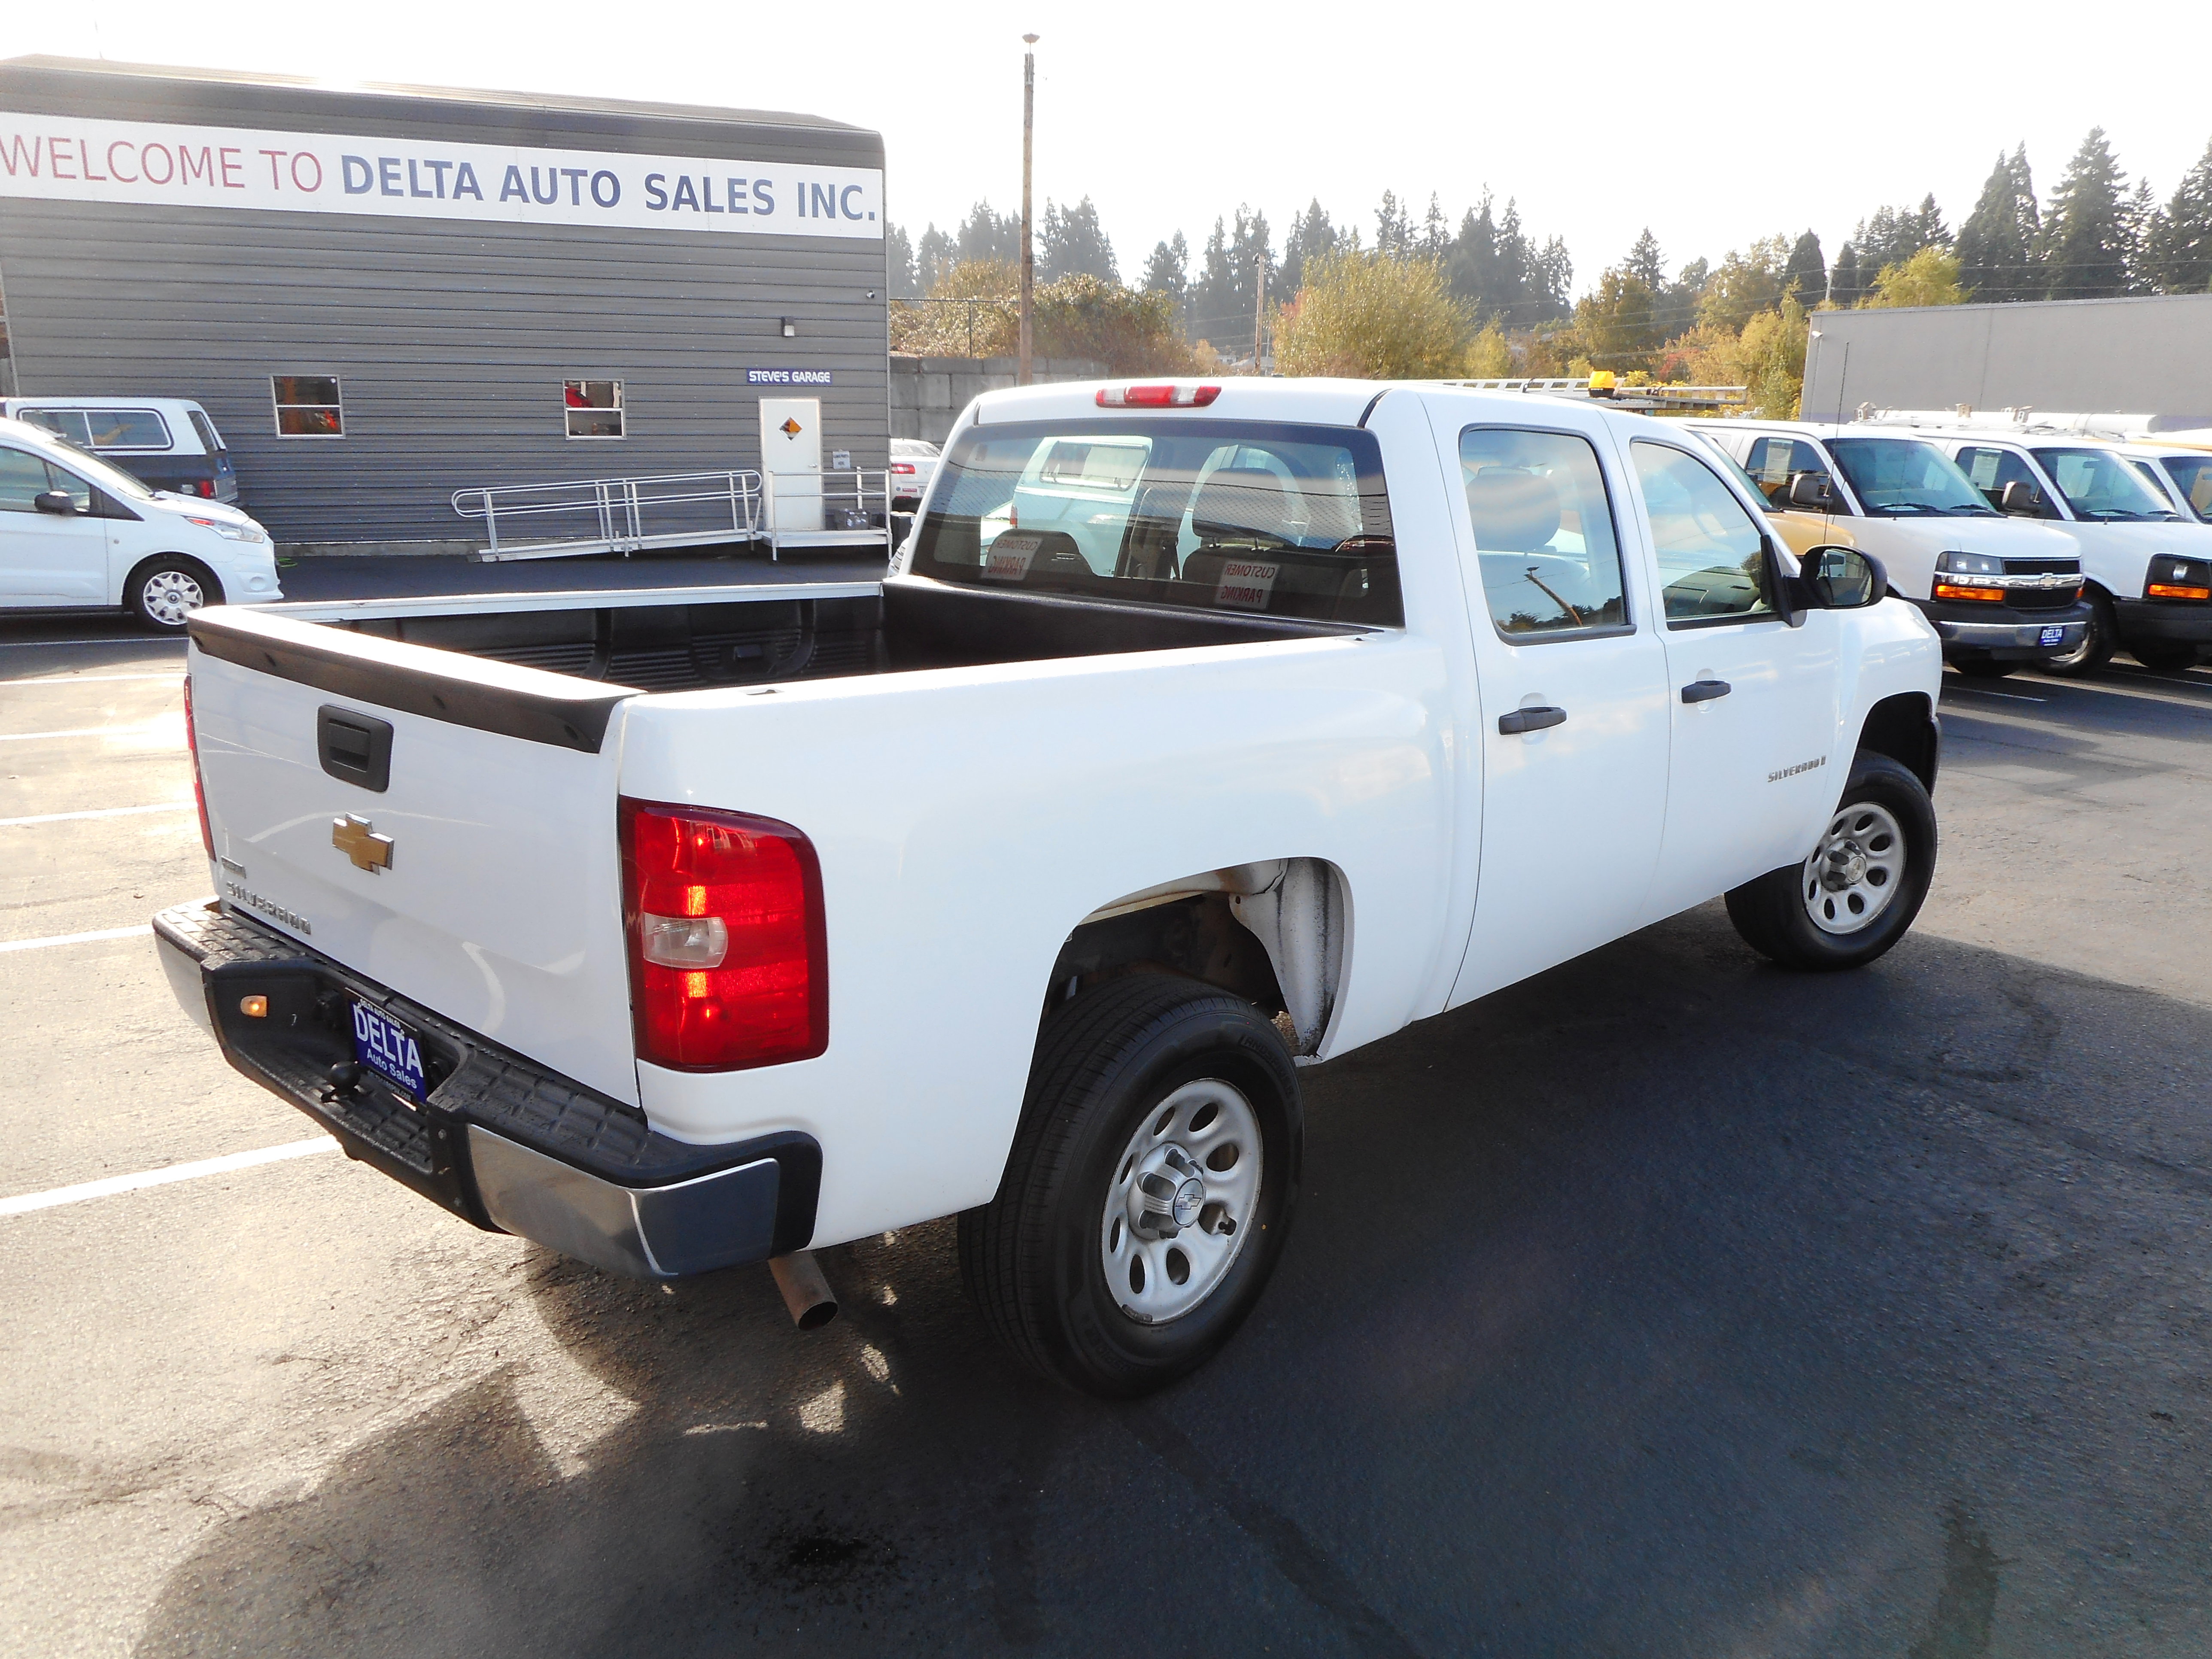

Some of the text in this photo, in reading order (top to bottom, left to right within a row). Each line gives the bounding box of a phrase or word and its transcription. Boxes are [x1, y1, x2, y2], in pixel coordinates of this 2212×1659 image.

[0, 134, 876, 221] WELCOME TO DELTA AUTO SALES INC.
[749, 371, 830, 383] STEVE'S GARAGE
[2041, 629, 2063, 639] DELTA
[352, 1003, 424, 1078] DELTA
[367, 1048, 387, 1071] Auto
[389, 1063, 417, 1089] Sales
